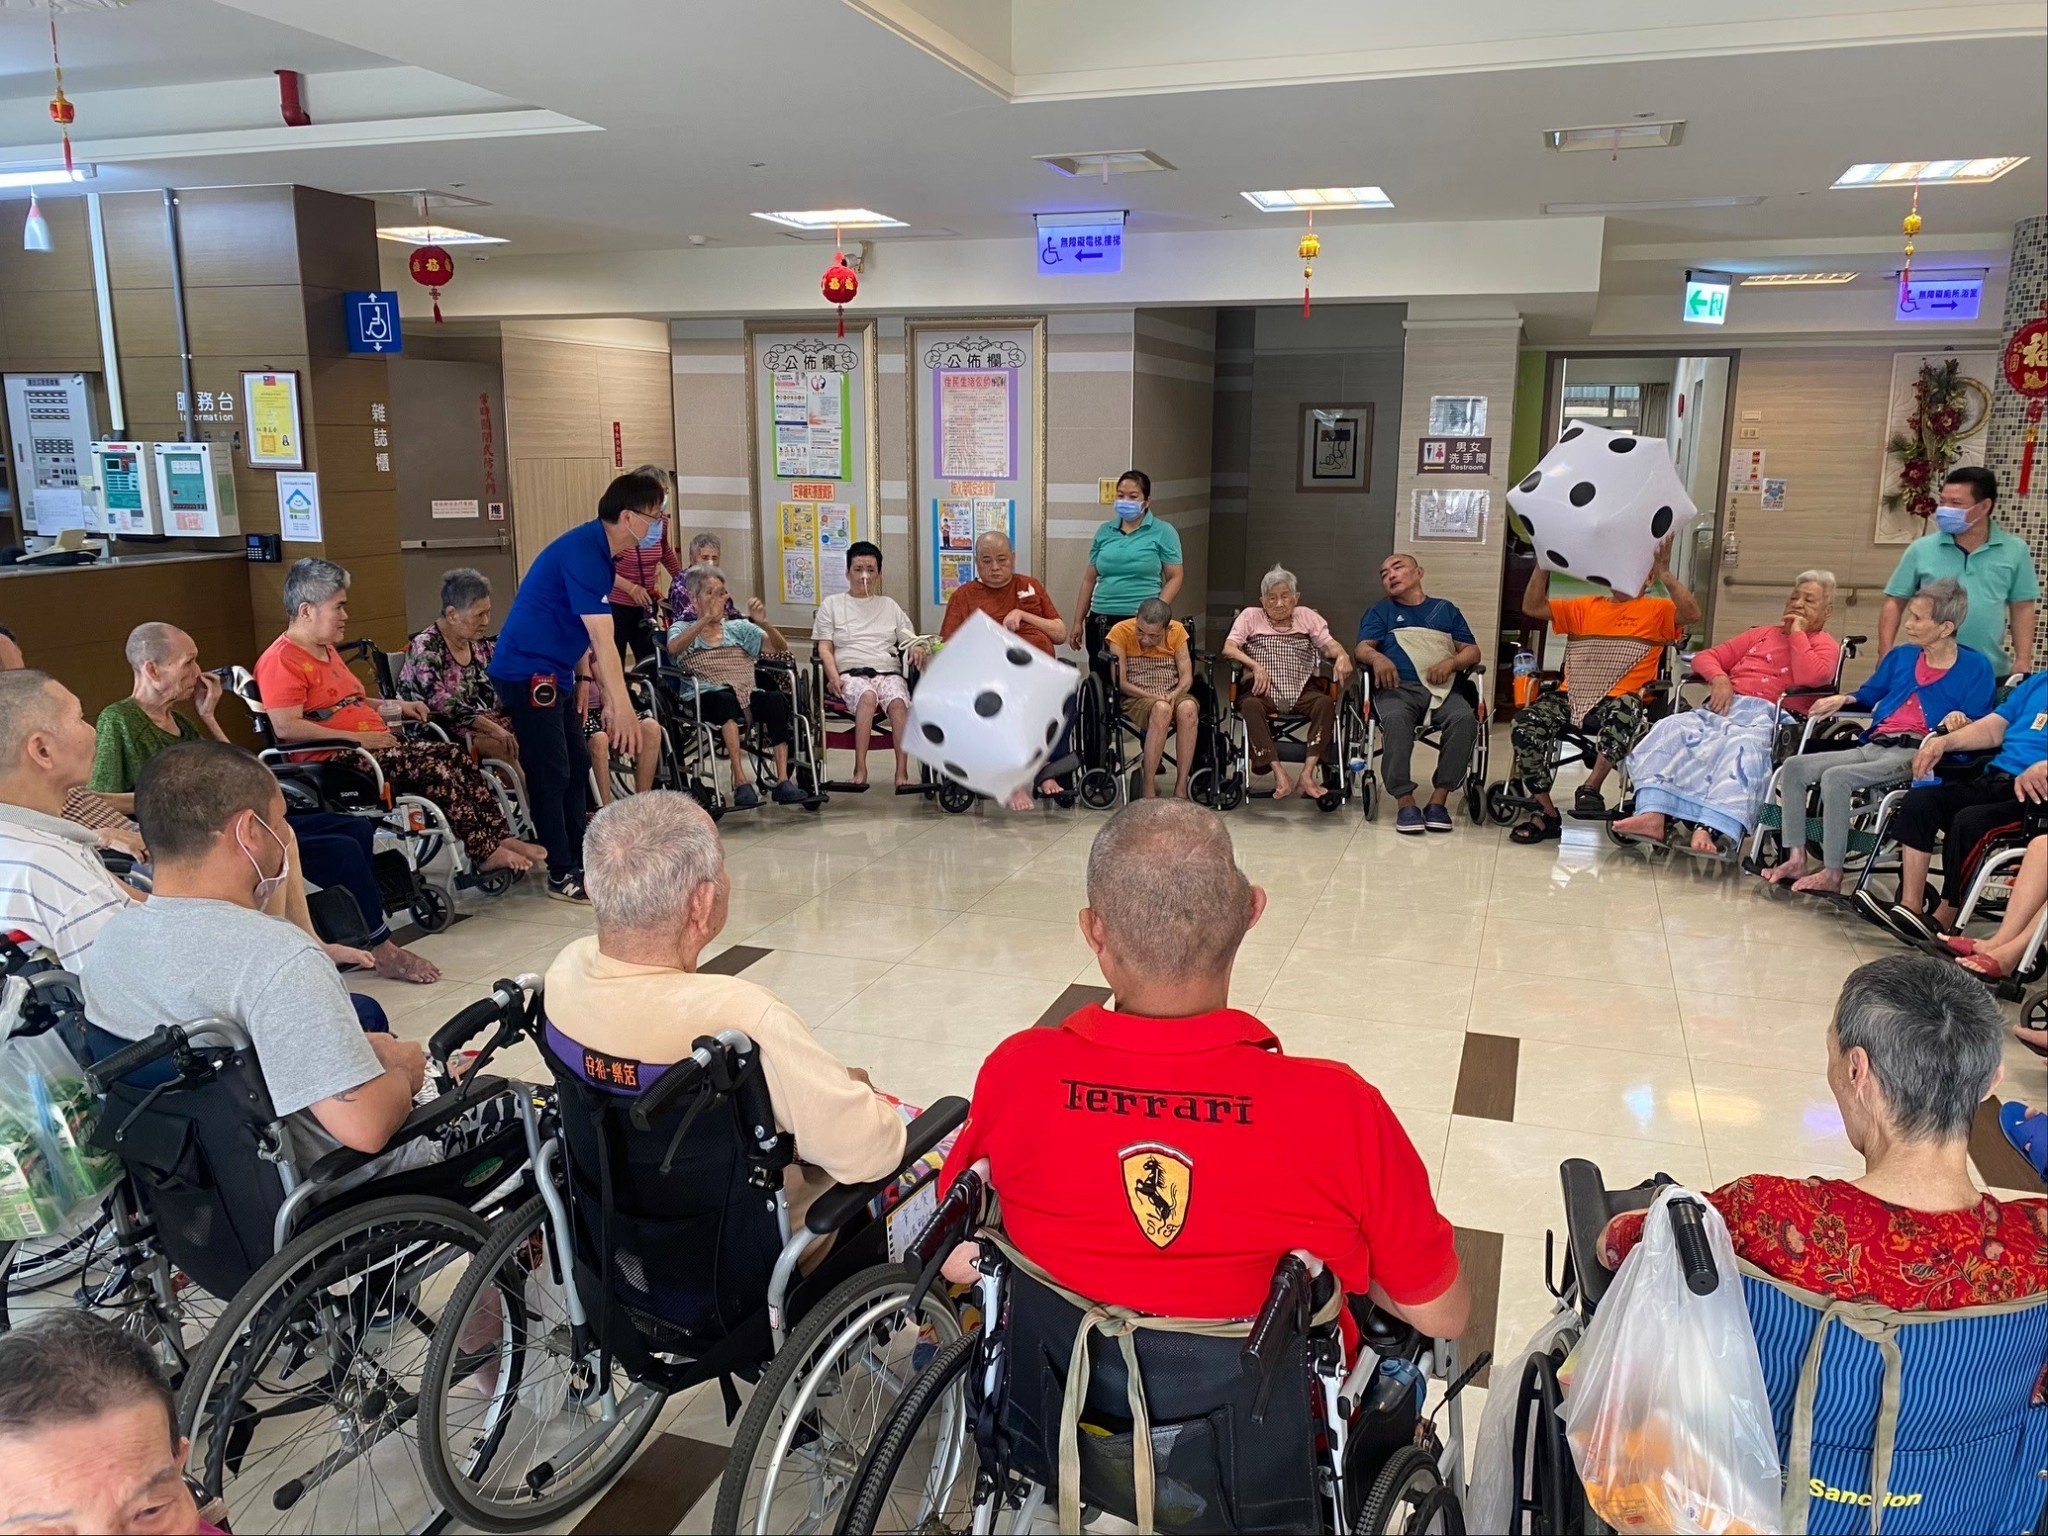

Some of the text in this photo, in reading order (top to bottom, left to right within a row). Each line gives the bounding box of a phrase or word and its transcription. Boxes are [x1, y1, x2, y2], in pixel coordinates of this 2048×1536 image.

[785, 354, 836, 370] 公佈欄
[947, 353, 1002, 368] 公佈欄
[371, 403, 390, 472] 雜誌櫃
[1456, 442, 1481, 452] 男女
[1449, 453, 1487, 464] 洗手間
[490, 504, 502, 515] 推
[1060, 1079, 1254, 1125] Ferrari
[1808, 1478, 1922, 1508] Sancion
